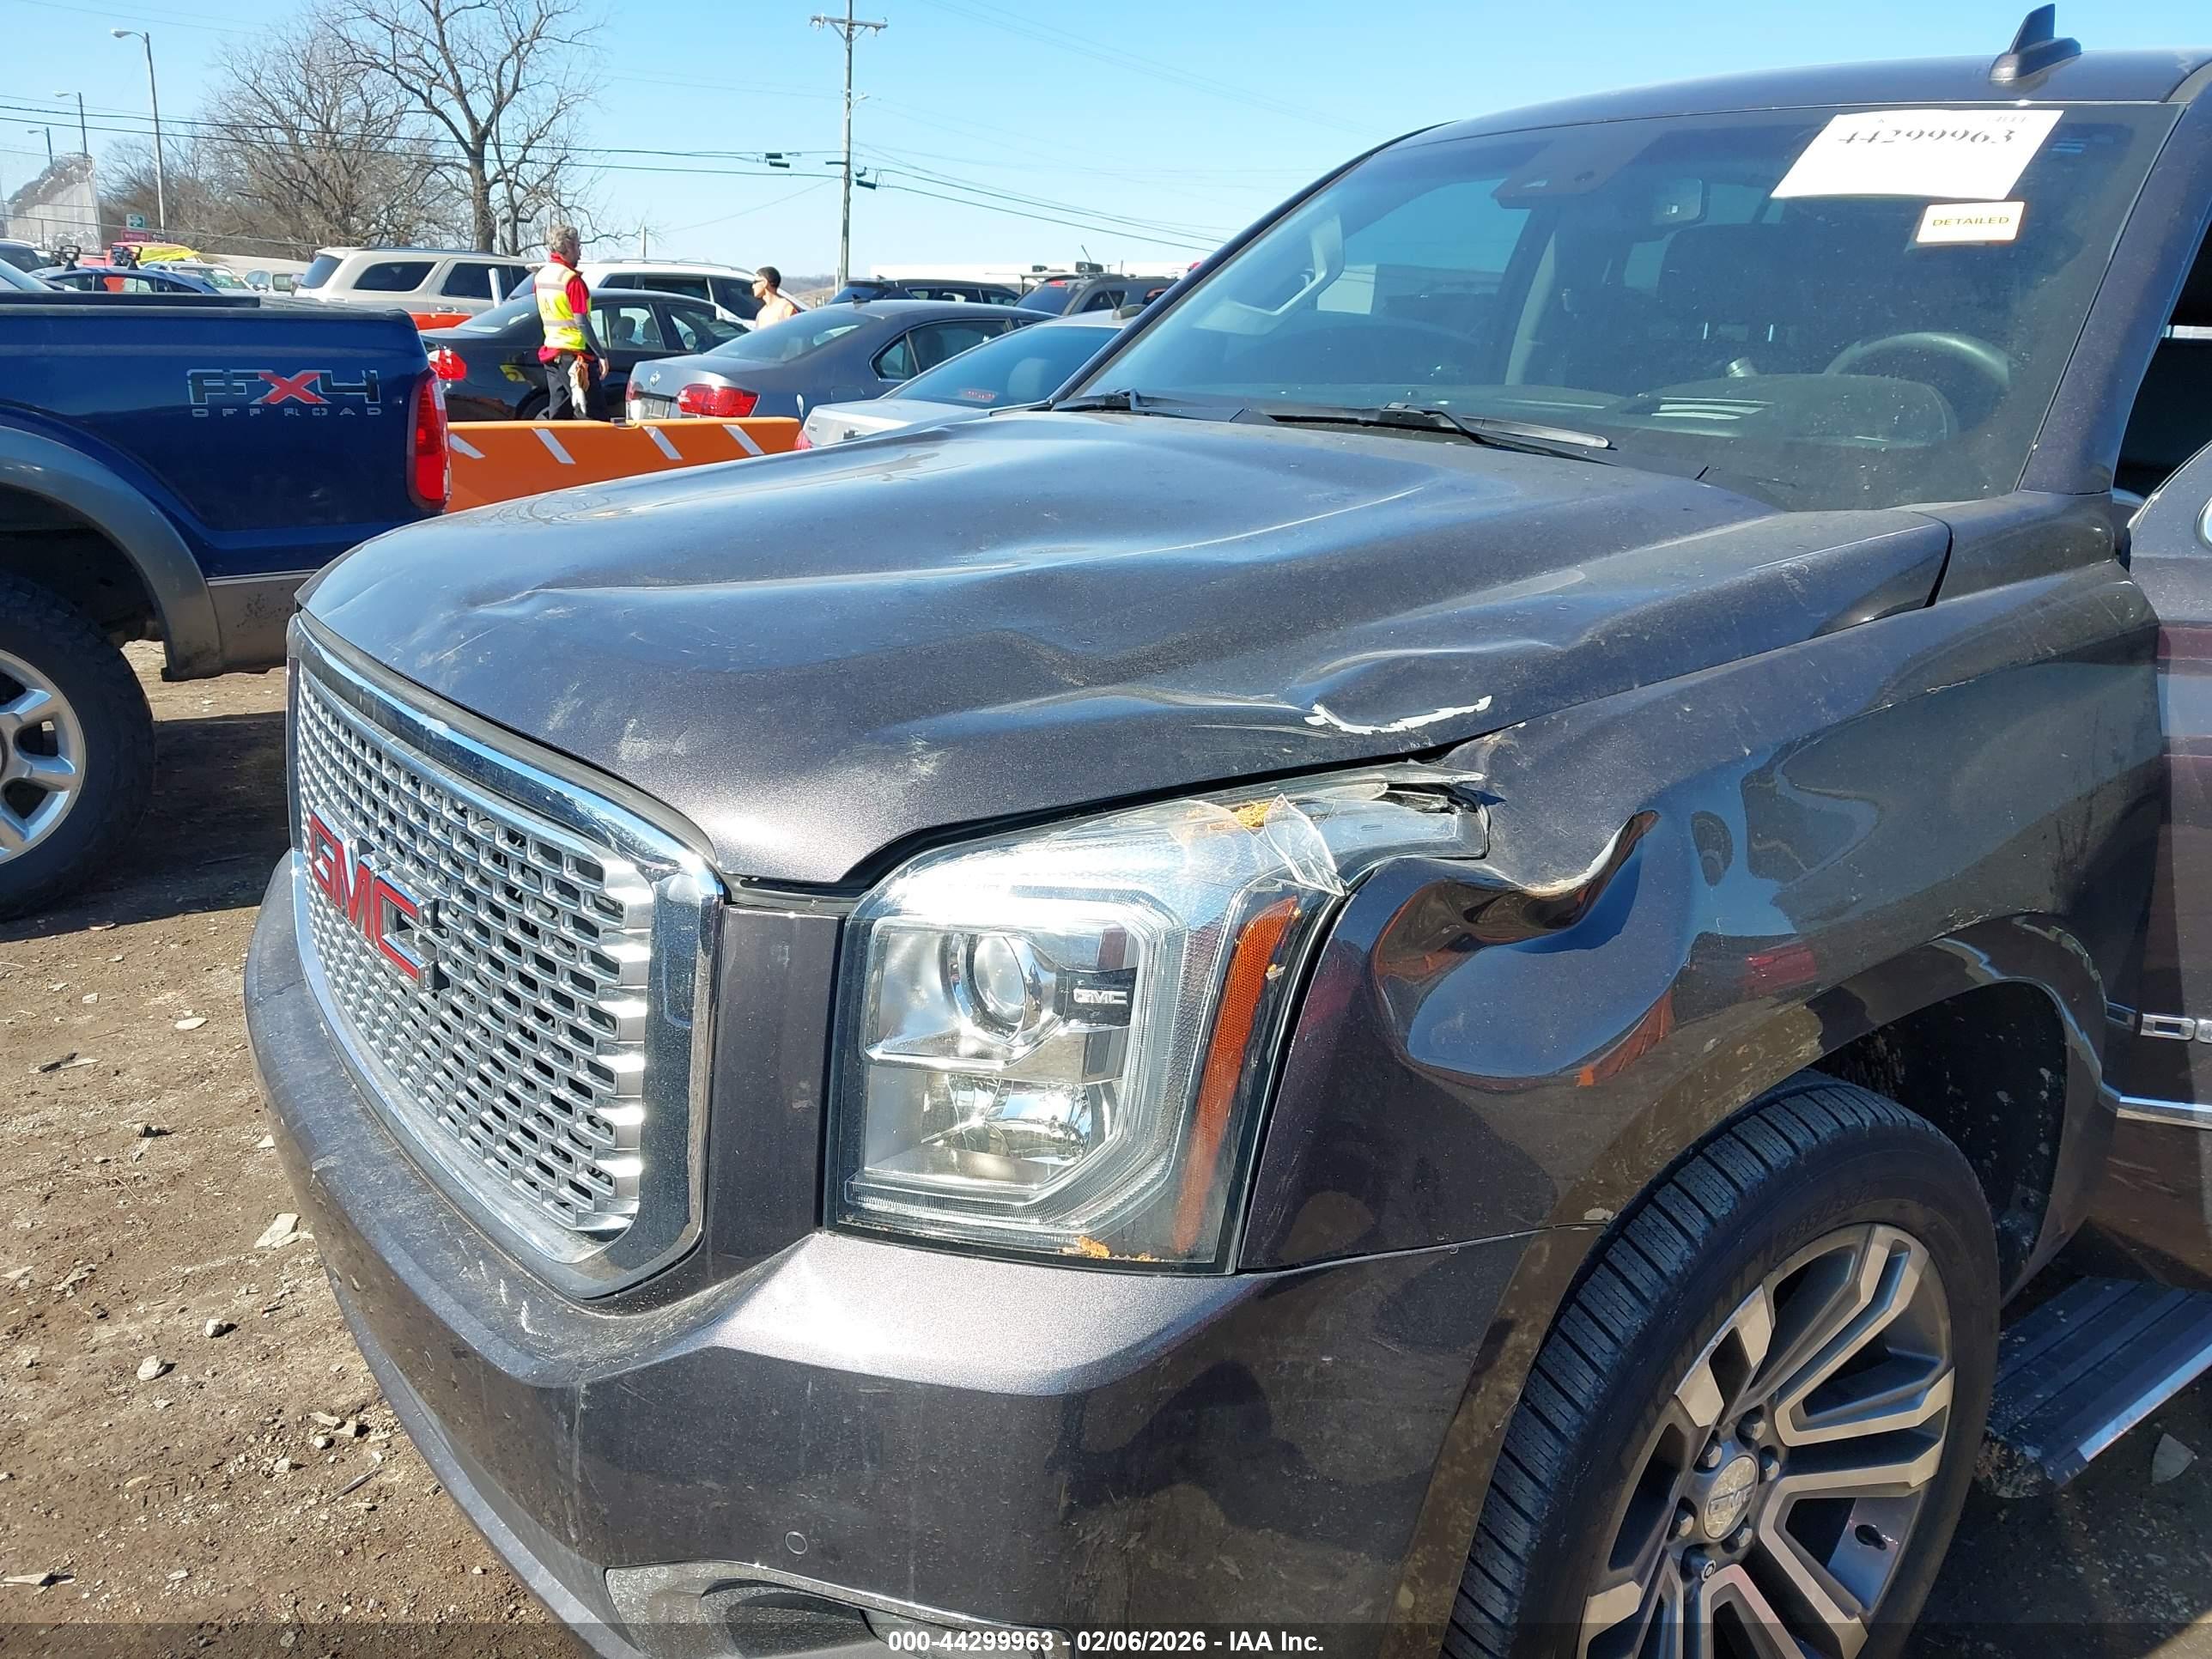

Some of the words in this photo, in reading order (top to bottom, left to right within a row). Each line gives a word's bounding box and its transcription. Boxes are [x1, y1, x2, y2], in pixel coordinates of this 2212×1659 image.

[1932, 216, 2010, 227] DETAILED
[186, 369, 381, 405] FX4
[191, 407, 264, 417] OFF
[283, 407, 382, 416] ROAD
[310, 805, 429, 987] GMC
[1073, 988, 1127, 1005] GMC
